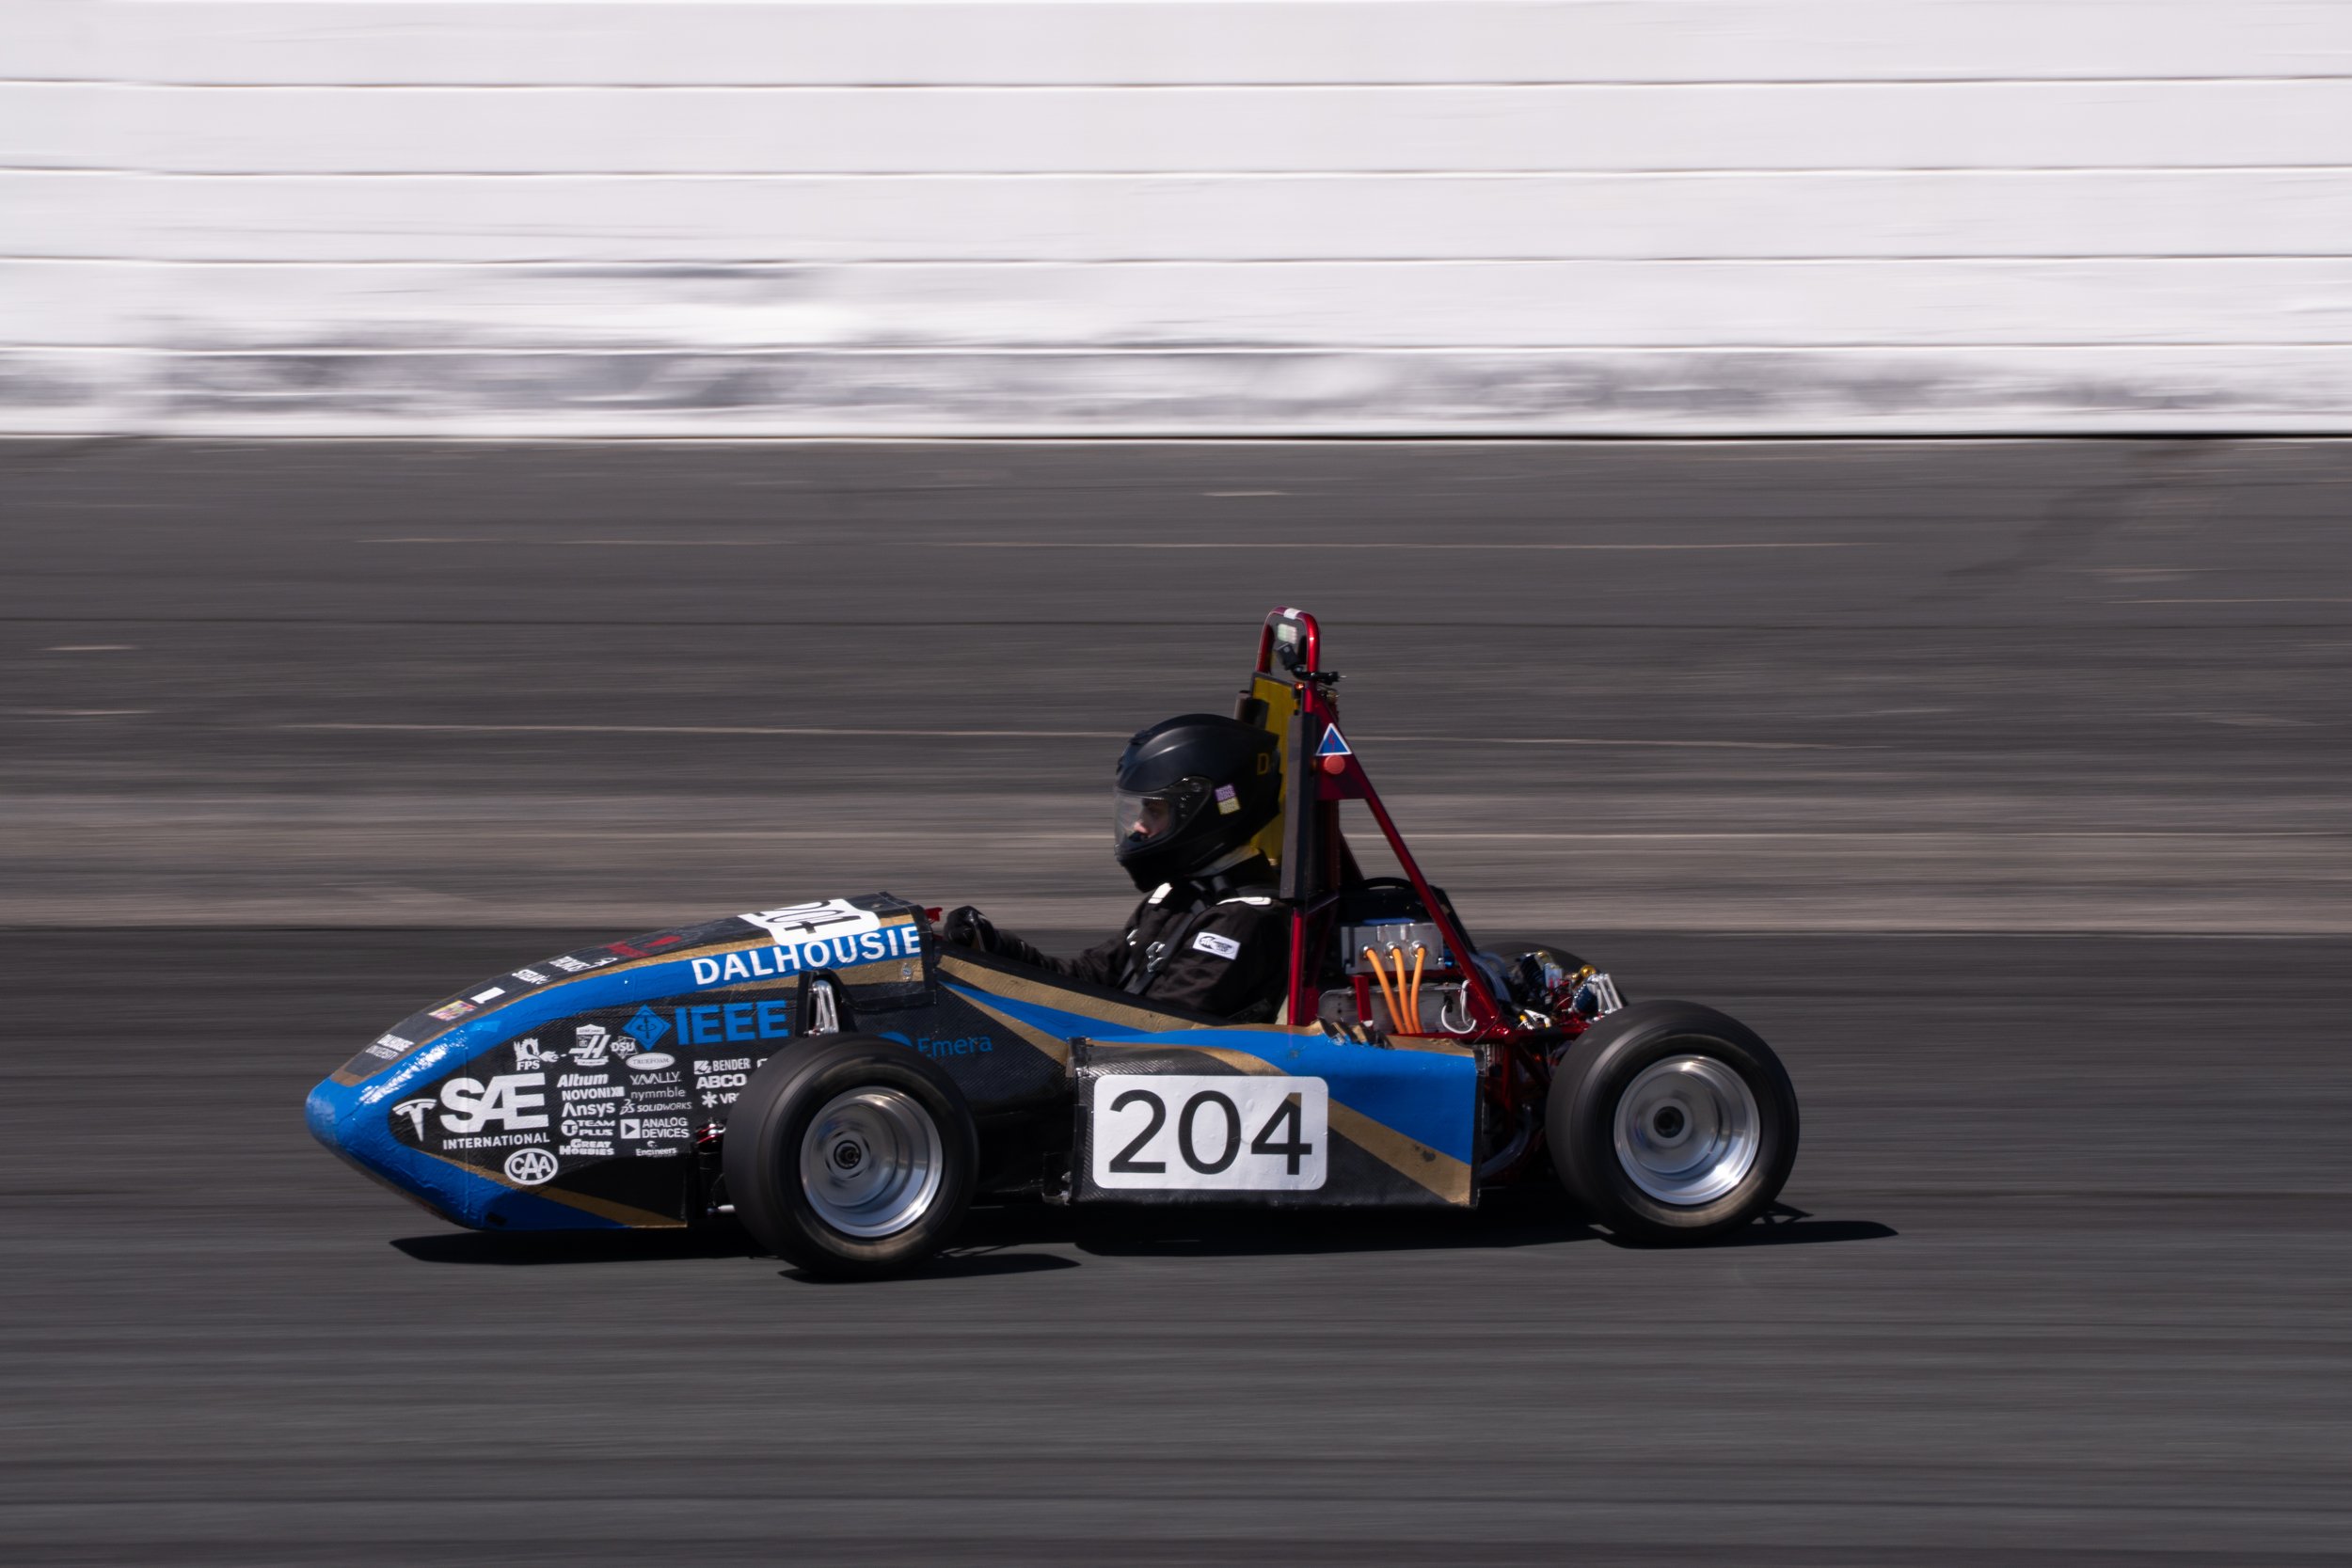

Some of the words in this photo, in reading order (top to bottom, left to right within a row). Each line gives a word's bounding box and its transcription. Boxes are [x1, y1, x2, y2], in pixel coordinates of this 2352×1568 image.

[691, 927, 921, 985] DALHOUSIE
[675, 1000, 789, 1045] IEEE
[611, 1041, 635, 1052] DSU
[516, 1060, 540, 1071] FPS
[712, 1057, 752, 1072] BENDER
[557, 1073, 610, 1087] Altium
[696, 1073, 747, 1089] ABCO
[562, 1086, 625, 1101] NOVONIX
[630, 1086, 686, 1101] nymmble
[720, 1093, 740, 1104] VR
[439, 1072, 549, 1133] SAE
[562, 1102, 615, 1117] Ansys
[637, 1101, 692, 1113] SOLIDWORKS
[642, 1117, 689, 1128] ANALOG
[642, 1128, 690, 1139] DEVICES
[1109, 1089, 1312, 1175] 204
[443, 1132, 550, 1150] INTERNATIONAL
[635, 1148, 677, 1157] Engineers
[511, 1152, 552, 1180] CAA
